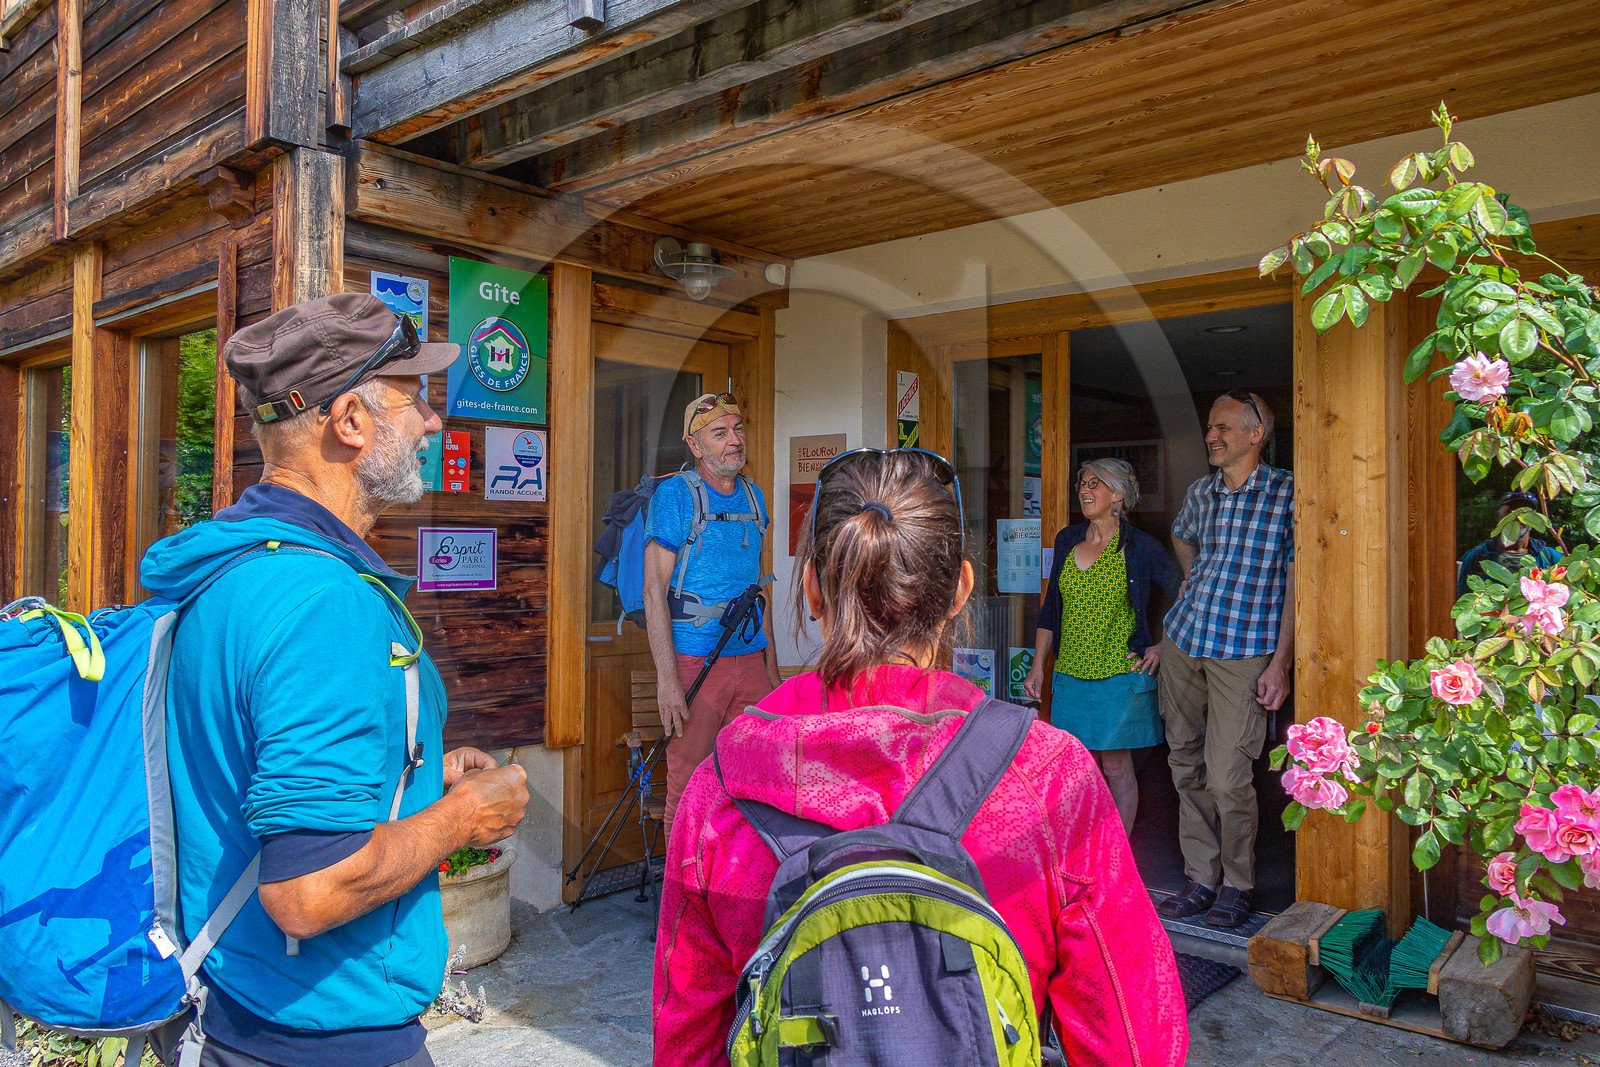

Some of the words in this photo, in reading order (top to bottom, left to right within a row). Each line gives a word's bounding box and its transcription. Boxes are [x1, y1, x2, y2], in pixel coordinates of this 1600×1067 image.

[478, 280, 521, 306] Gîte
[487, 377, 501, 388] DE
[504, 352, 528, 388] FRANCE
[456, 398, 538, 415] gites-de-france.com
[802, 446, 838, 458] FLOUROU
[434, 535, 487, 571] Esprit
[462, 556, 486, 564] PARC
